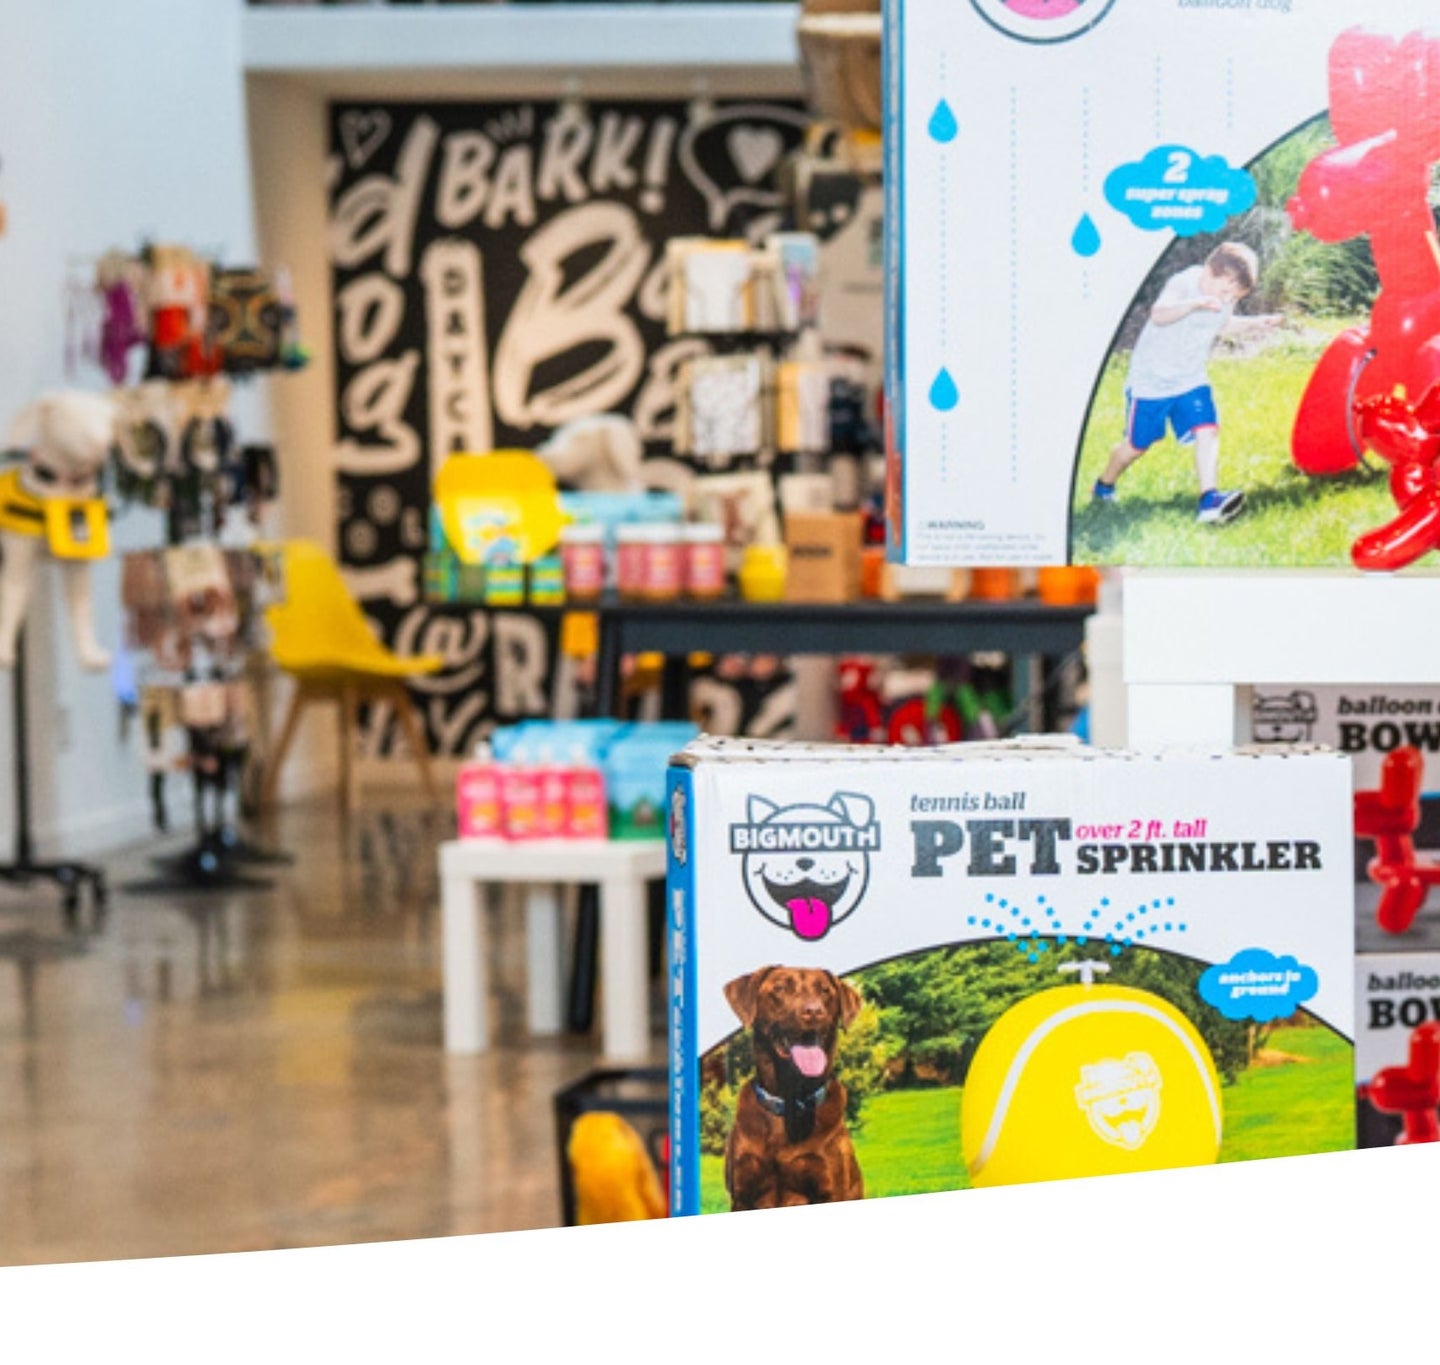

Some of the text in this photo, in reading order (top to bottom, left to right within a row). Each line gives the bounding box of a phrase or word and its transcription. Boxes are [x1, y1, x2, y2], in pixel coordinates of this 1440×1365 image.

[434, 109, 678, 230] BARK!
[1162, 151, 1192, 184] 2
[1337, 695, 1433, 716] balloon
[910, 789, 1027, 813] tennis ball
[733, 825, 876, 849] BIGMOUTH
[1076, 818, 1208, 844] over 2 ft. tall
[910, 818, 1323, 878] PET SPRINKLER
